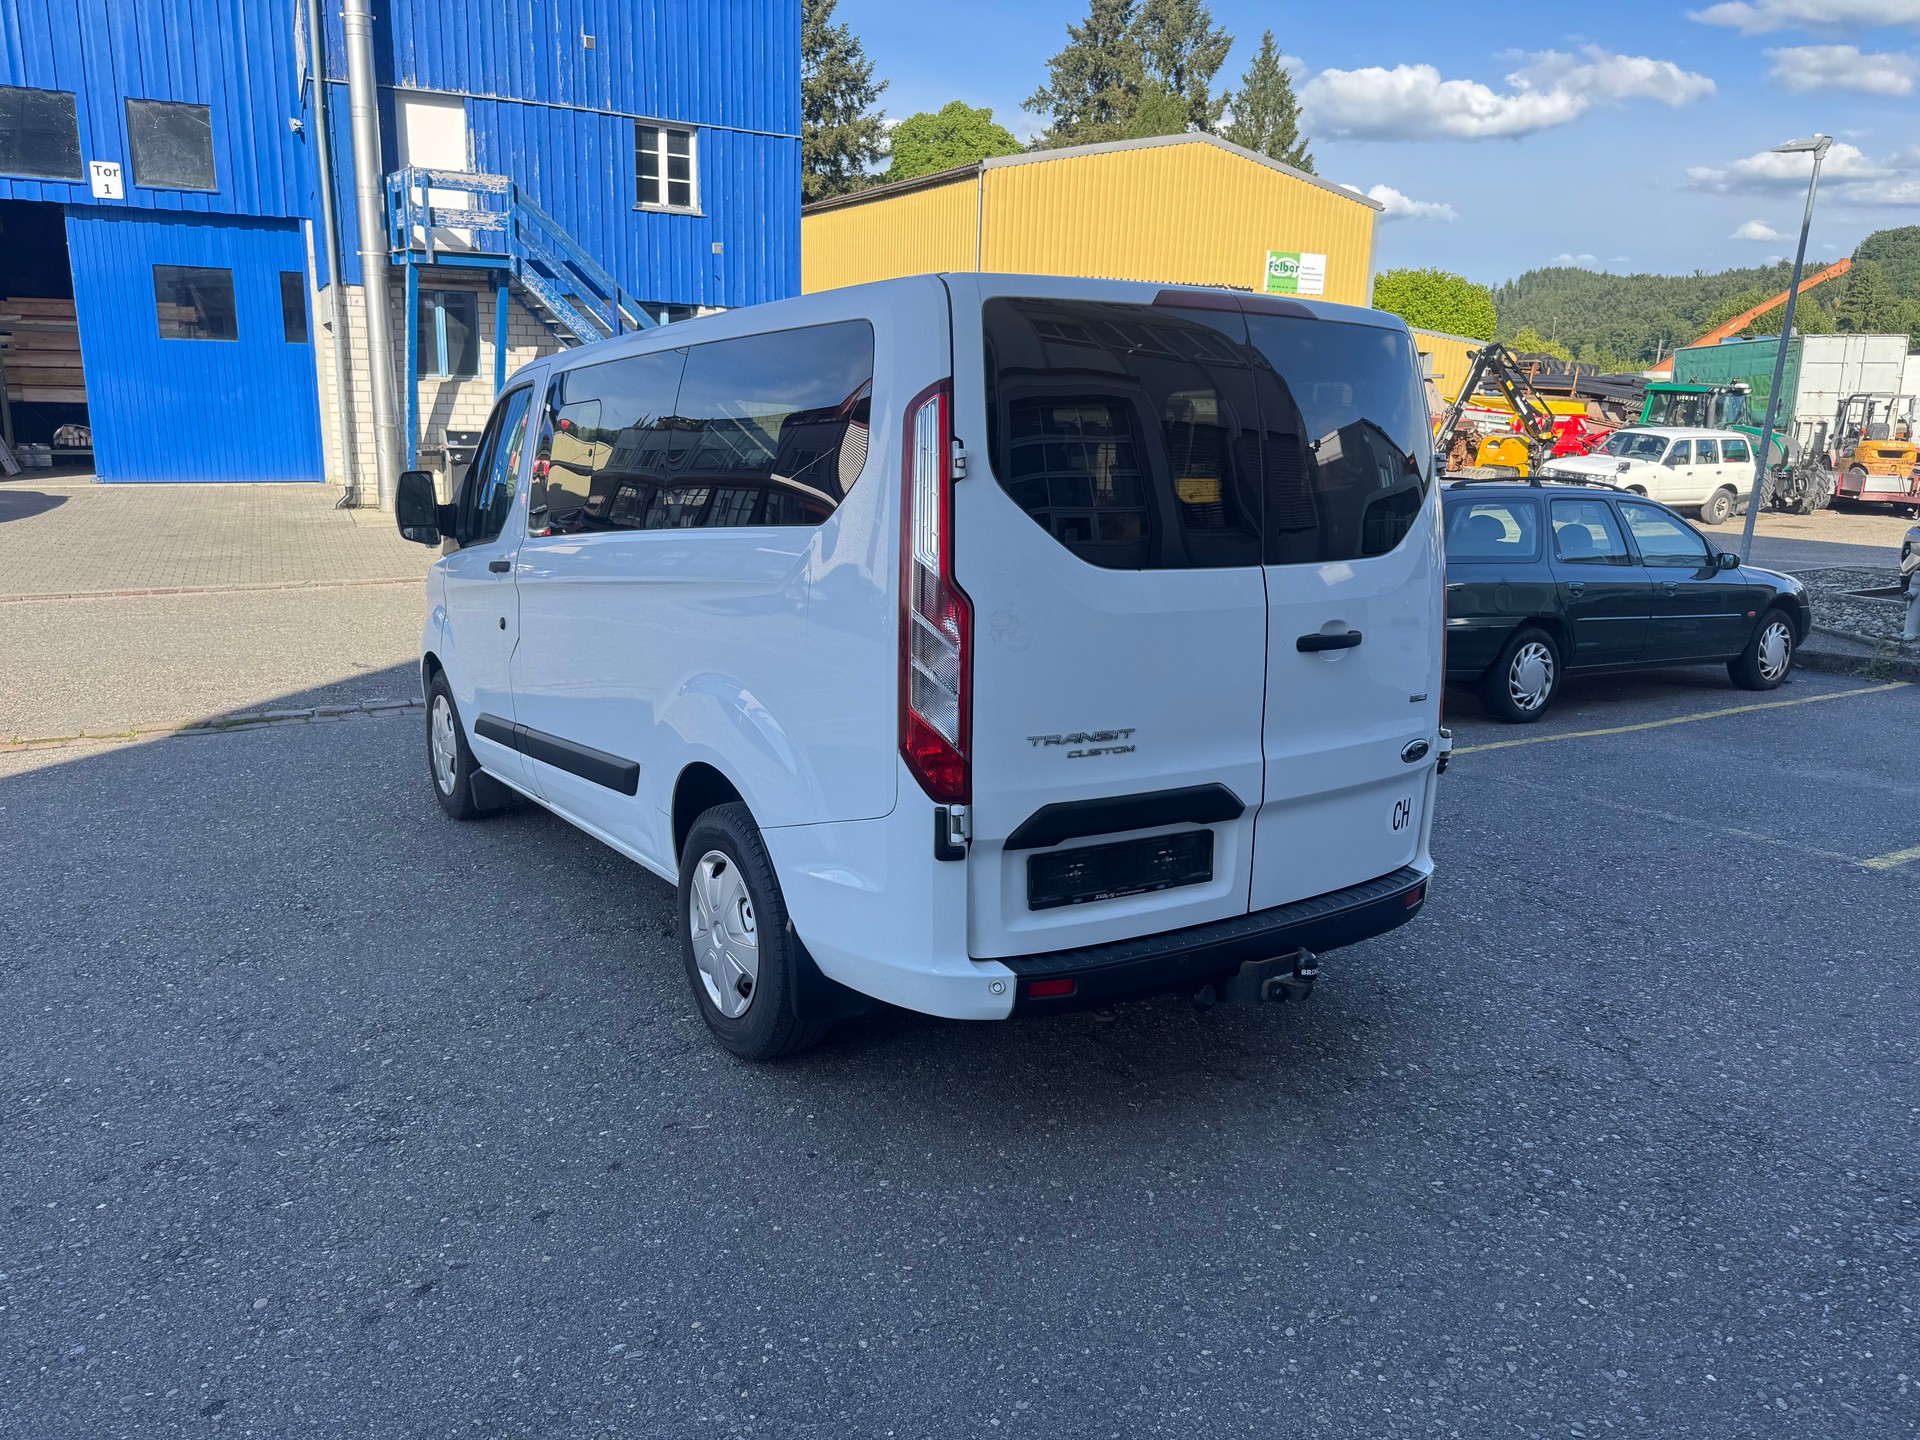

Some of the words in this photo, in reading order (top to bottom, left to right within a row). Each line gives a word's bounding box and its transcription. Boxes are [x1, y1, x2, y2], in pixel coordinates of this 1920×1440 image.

[92, 164, 120, 178] Tor
[103, 183, 113, 195] 1
[1026, 728, 1136, 747] TRANSIT
[1066, 744, 1136, 759] CUSTOM
[1392, 797, 1411, 831] CH
